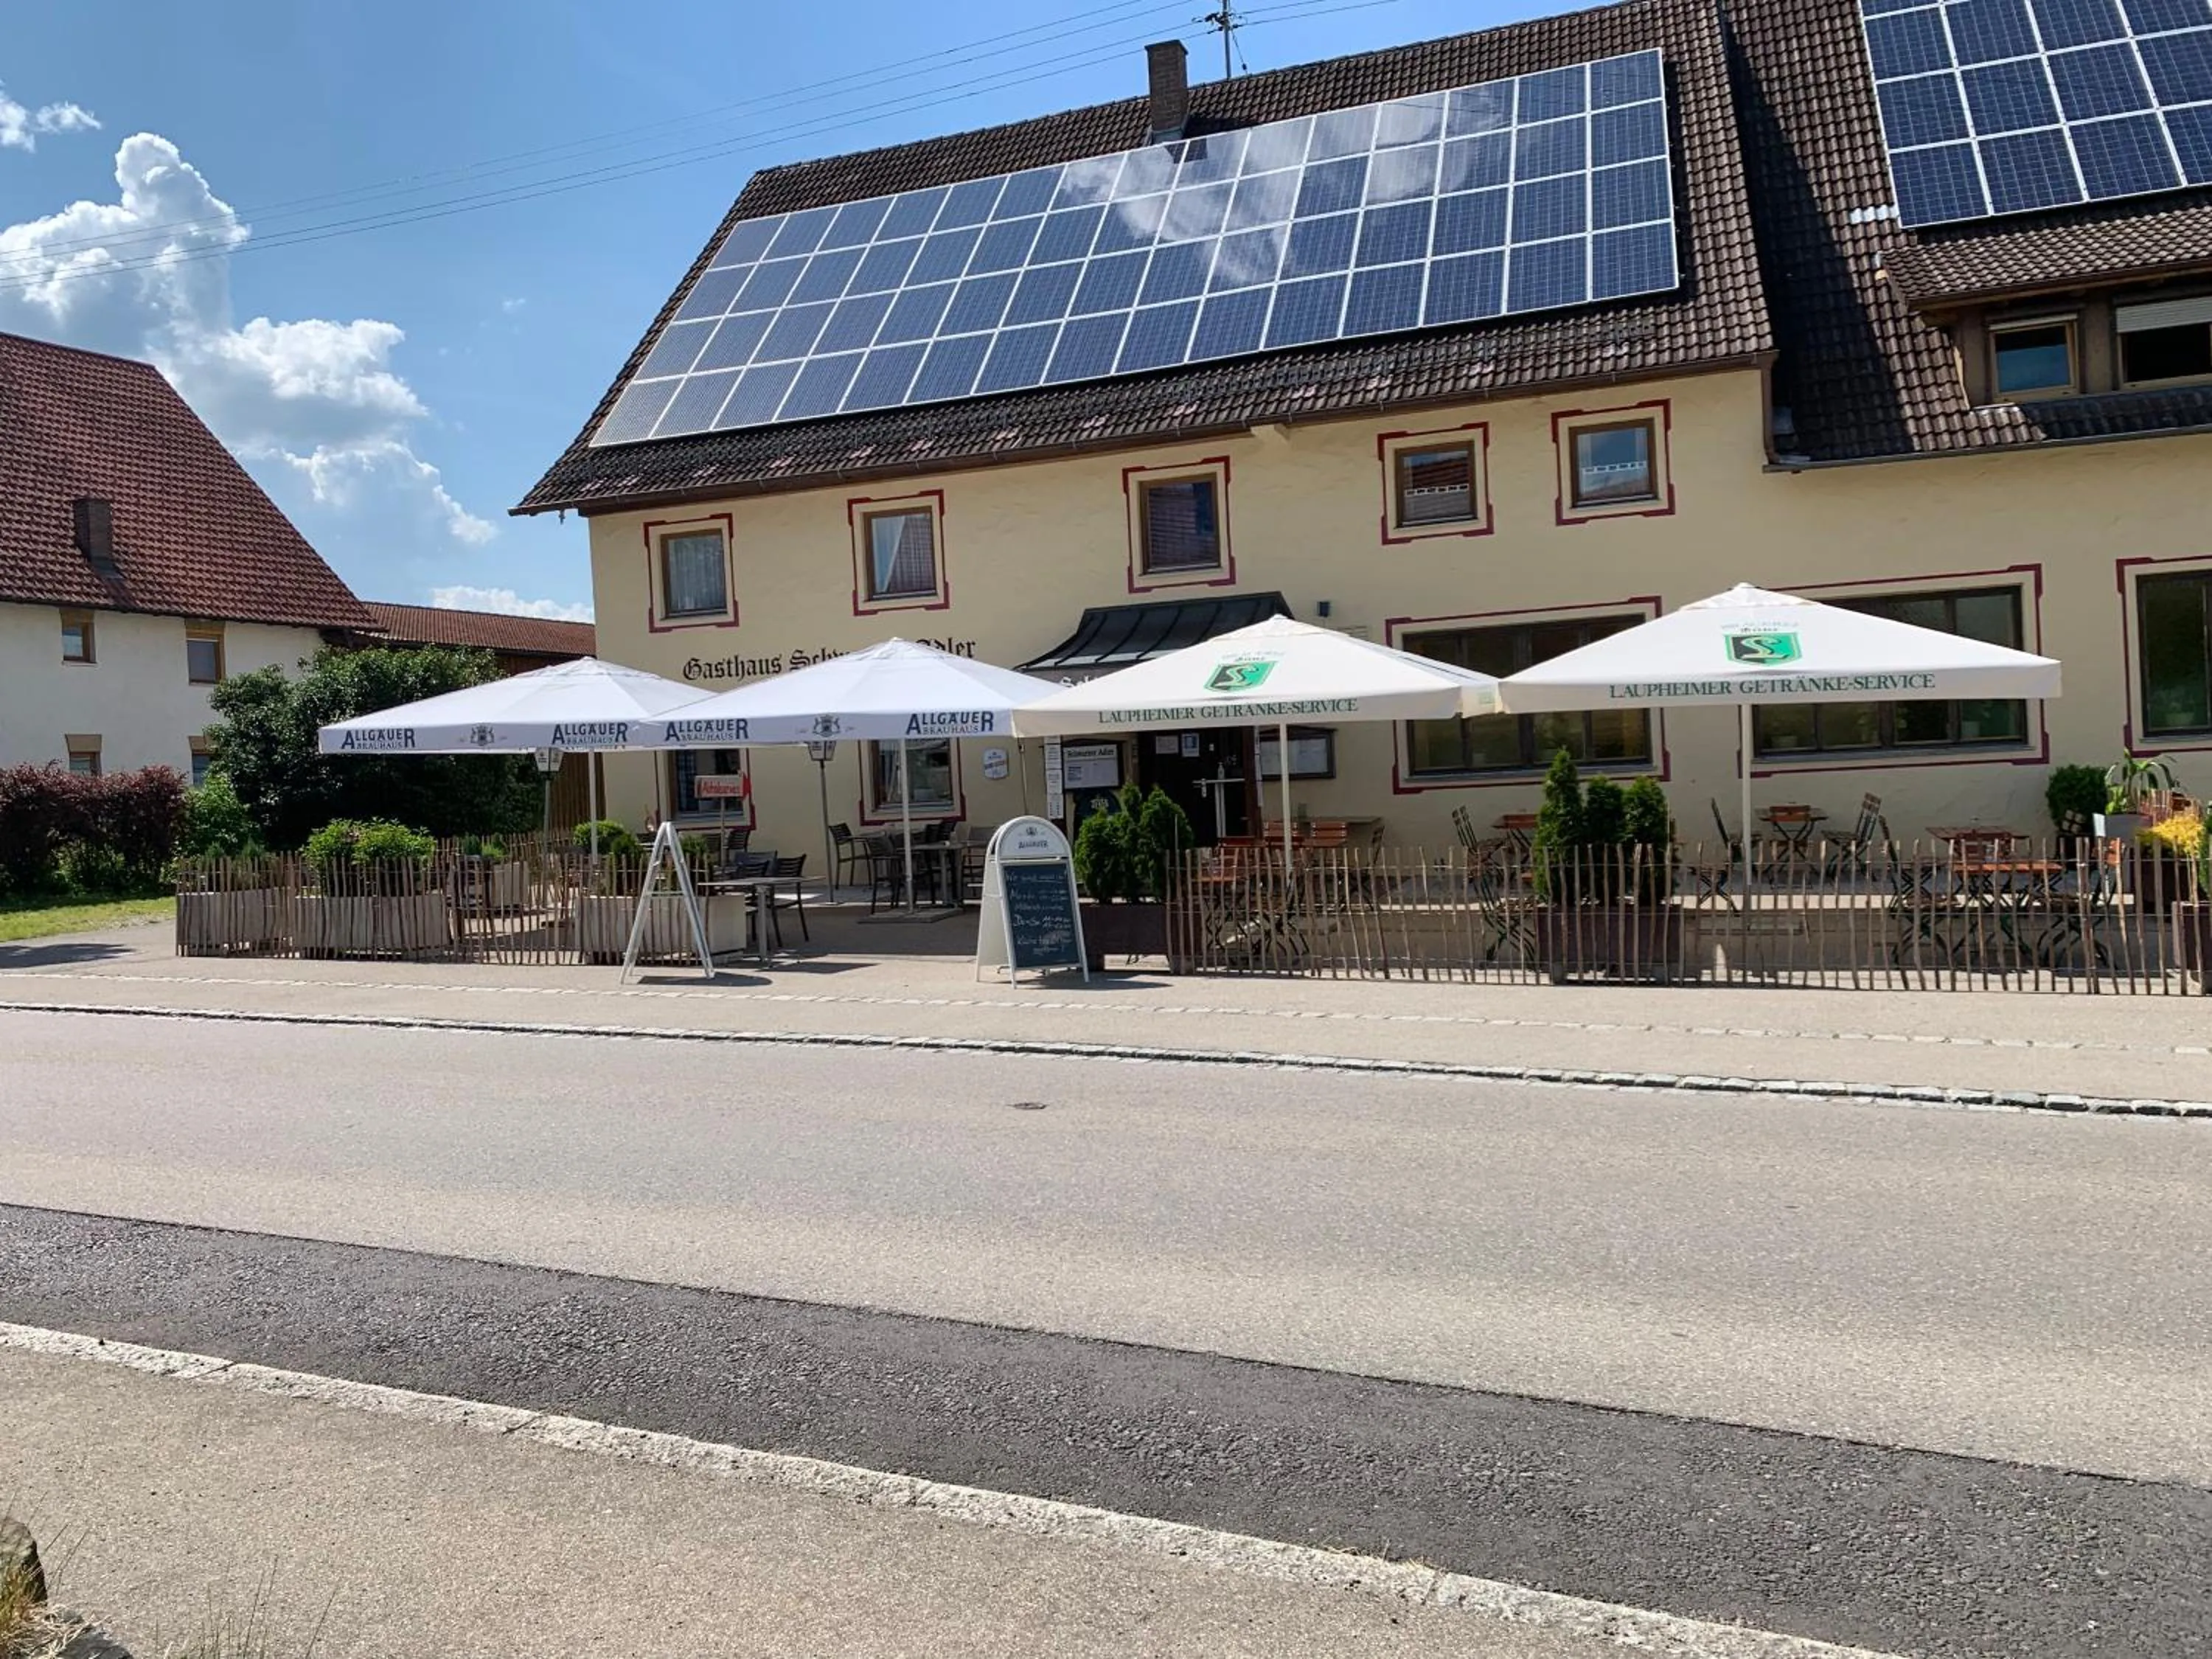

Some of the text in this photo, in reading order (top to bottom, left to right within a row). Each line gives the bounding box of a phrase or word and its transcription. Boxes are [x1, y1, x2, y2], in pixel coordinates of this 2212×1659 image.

[683, 654, 783, 681] Gasthaus
[1610, 673, 1936, 698] LAUPHEIMER GETRÄNKE-SERVICE
[905, 711, 994, 735] ALLGÄUER
[1098, 706, 1195, 723] LAUPHEIMER
[341, 728, 416, 749] ALLGÄUER
[552, 722, 627, 744] ALLGÄUER
[665, 718, 749, 742] ALLGÄUER
[681, 733, 734, 741] BRAUHAUS
[922, 726, 979, 734] BRAUHAUS
[357, 741, 402, 750] BRAUHAUS
